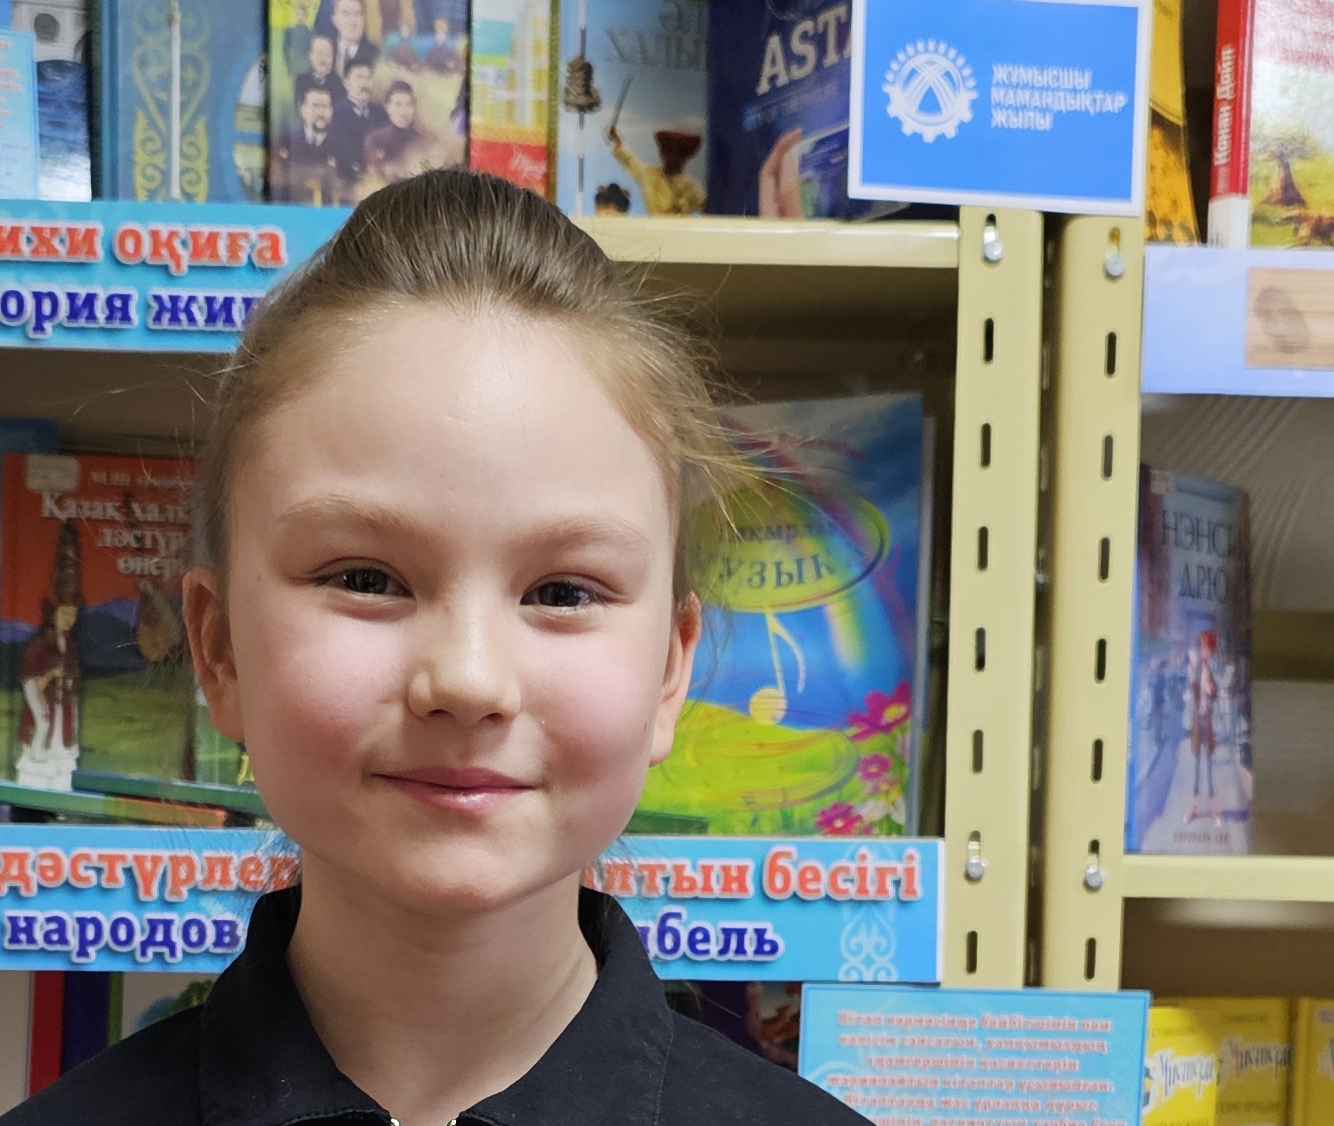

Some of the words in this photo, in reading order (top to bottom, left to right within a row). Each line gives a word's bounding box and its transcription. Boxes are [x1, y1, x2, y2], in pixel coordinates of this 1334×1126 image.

[1217, 45, 1235, 100] Дойл
[990, 86, 1129, 116] МАМАНДЫҚТАР
[991, 108, 1053, 131] ЖЫЛЫ
[1214, 102, 1232, 166] Конан
[114, 226, 286, 275] оқиға
[761, 848, 921, 901] бесігі
[7, 911, 243, 960] народов
